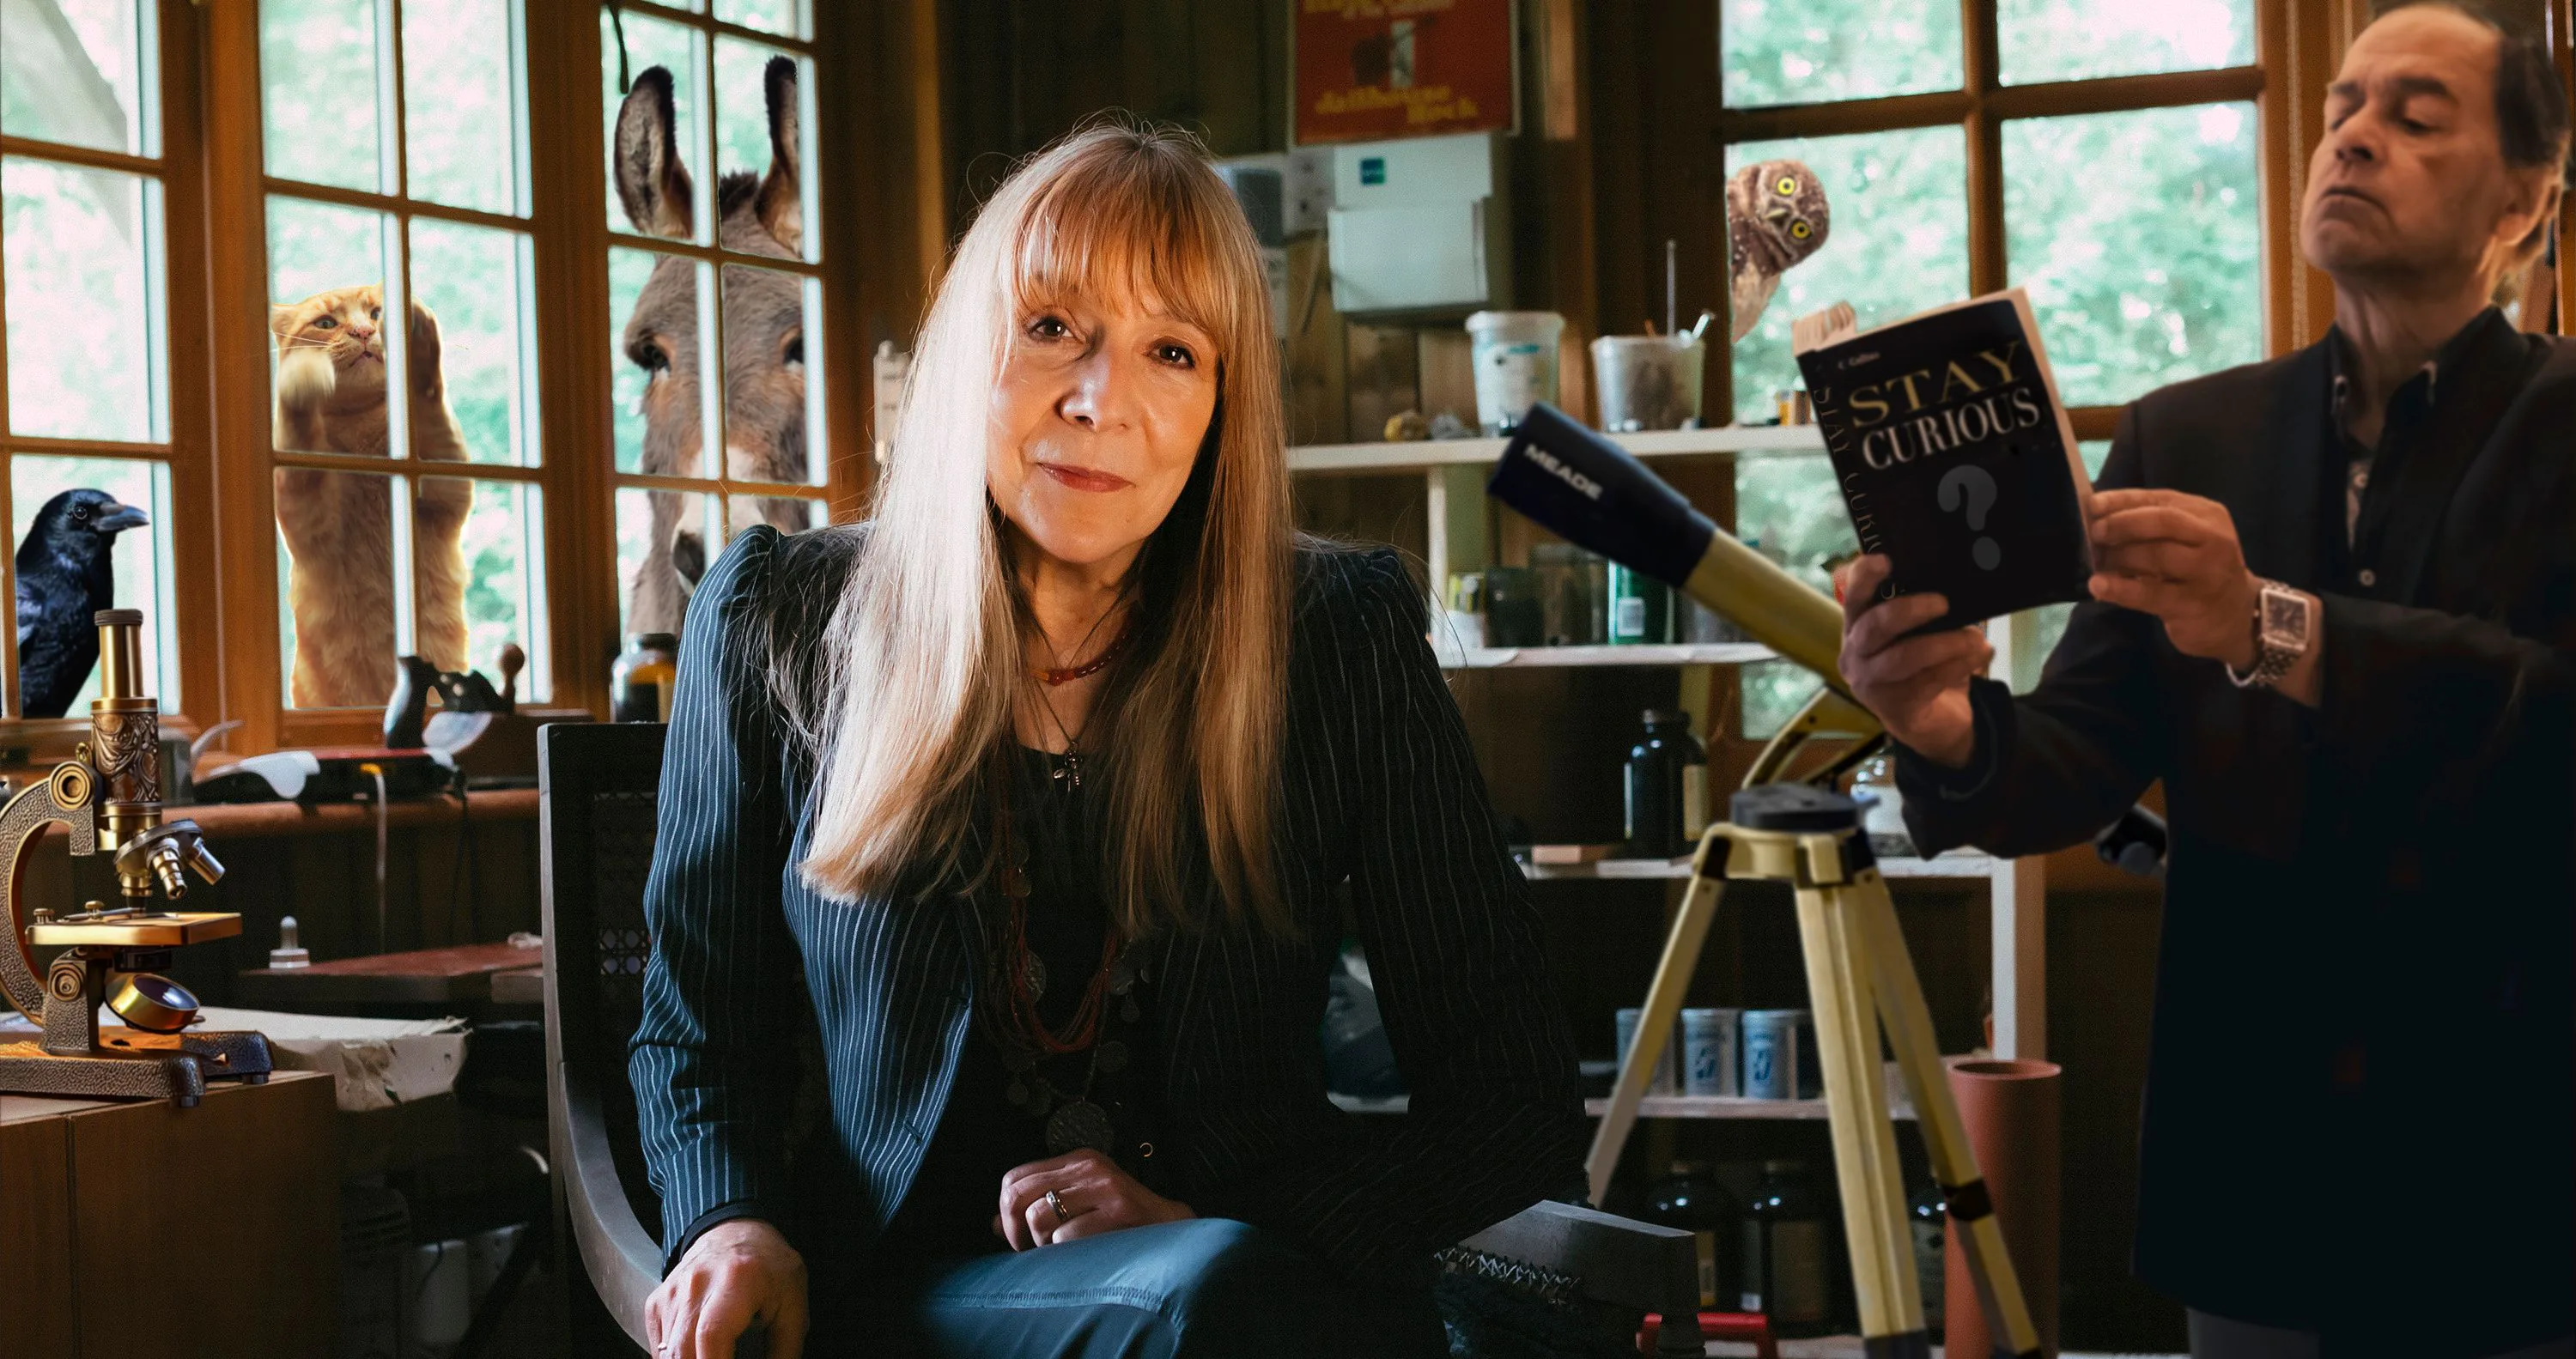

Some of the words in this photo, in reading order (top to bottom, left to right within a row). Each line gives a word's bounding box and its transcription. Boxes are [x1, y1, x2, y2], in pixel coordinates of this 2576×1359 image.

[1849, 341, 2021, 428] STAY
[1862, 387, 2040, 470] CURIOUS
[1523, 443, 1603, 501] MEADE
